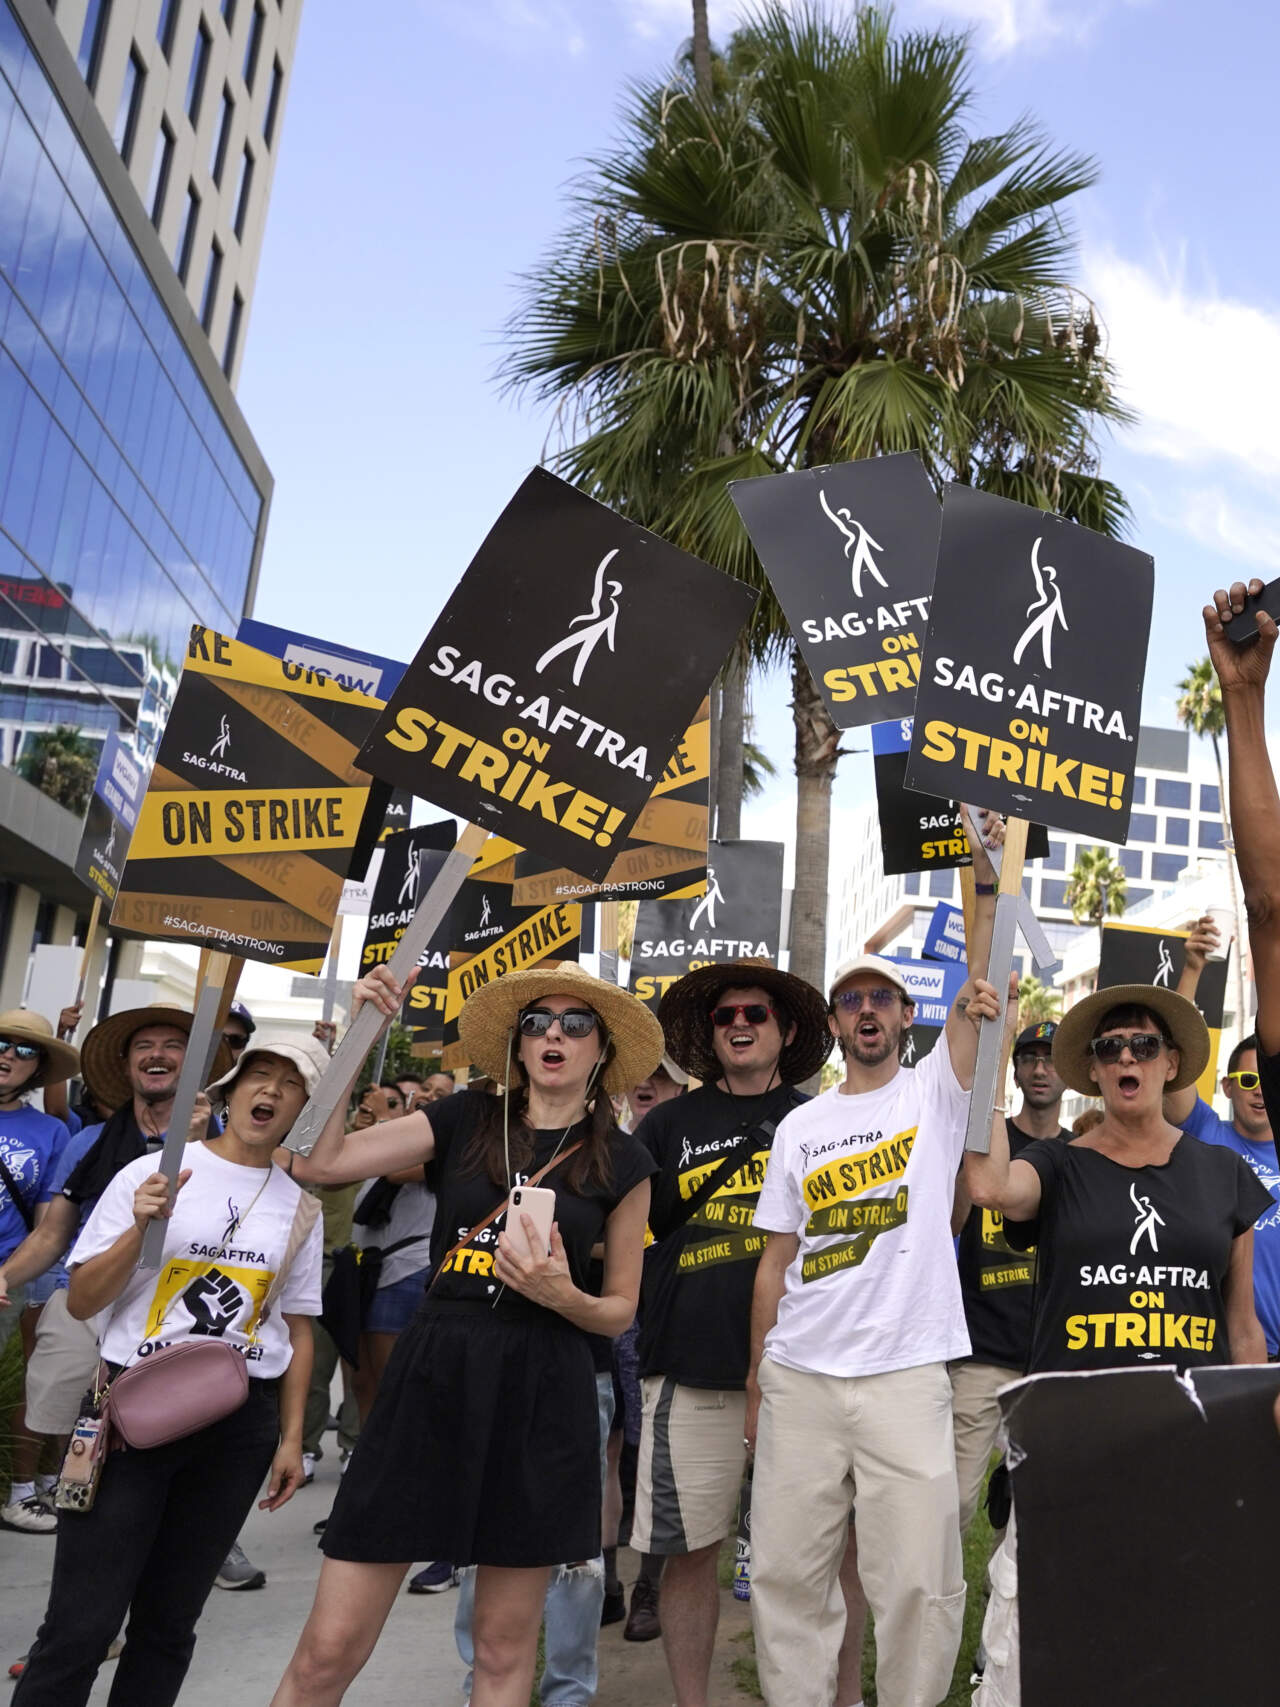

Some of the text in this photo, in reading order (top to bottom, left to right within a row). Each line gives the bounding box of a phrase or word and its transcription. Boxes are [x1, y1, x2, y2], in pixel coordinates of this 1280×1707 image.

[881, 632, 919, 655] ON
[502, 726, 551, 764] ON
[1008, 718, 1049, 747] ON
[384, 706, 628, 847] STRIKE!
[920, 720, 1127, 811] STRIKE!
[162, 801, 212, 845] ON
[224, 797, 345, 843] STRIKE
[163, 915, 286, 956] #SAGAFTRASTRONG
[459, 903, 572, 1001] ON STRIKE
[922, 1002, 948, 1020] WITH
[807, 1169, 837, 1202] ON
[705, 1202, 725, 1221] ON
[828, 1207, 849, 1228] ON
[679, 1251, 696, 1268] ON
[696, 1242, 732, 1264] STRIKE
[744, 1237, 762, 1252] ON
[803, 1245, 857, 1277] ON STRIKE
[981, 1267, 1030, 1286] ON STRIKE
[1129, 1291, 1165, 1309] ON
[1065, 1312, 1217, 1352] STRIKE!
